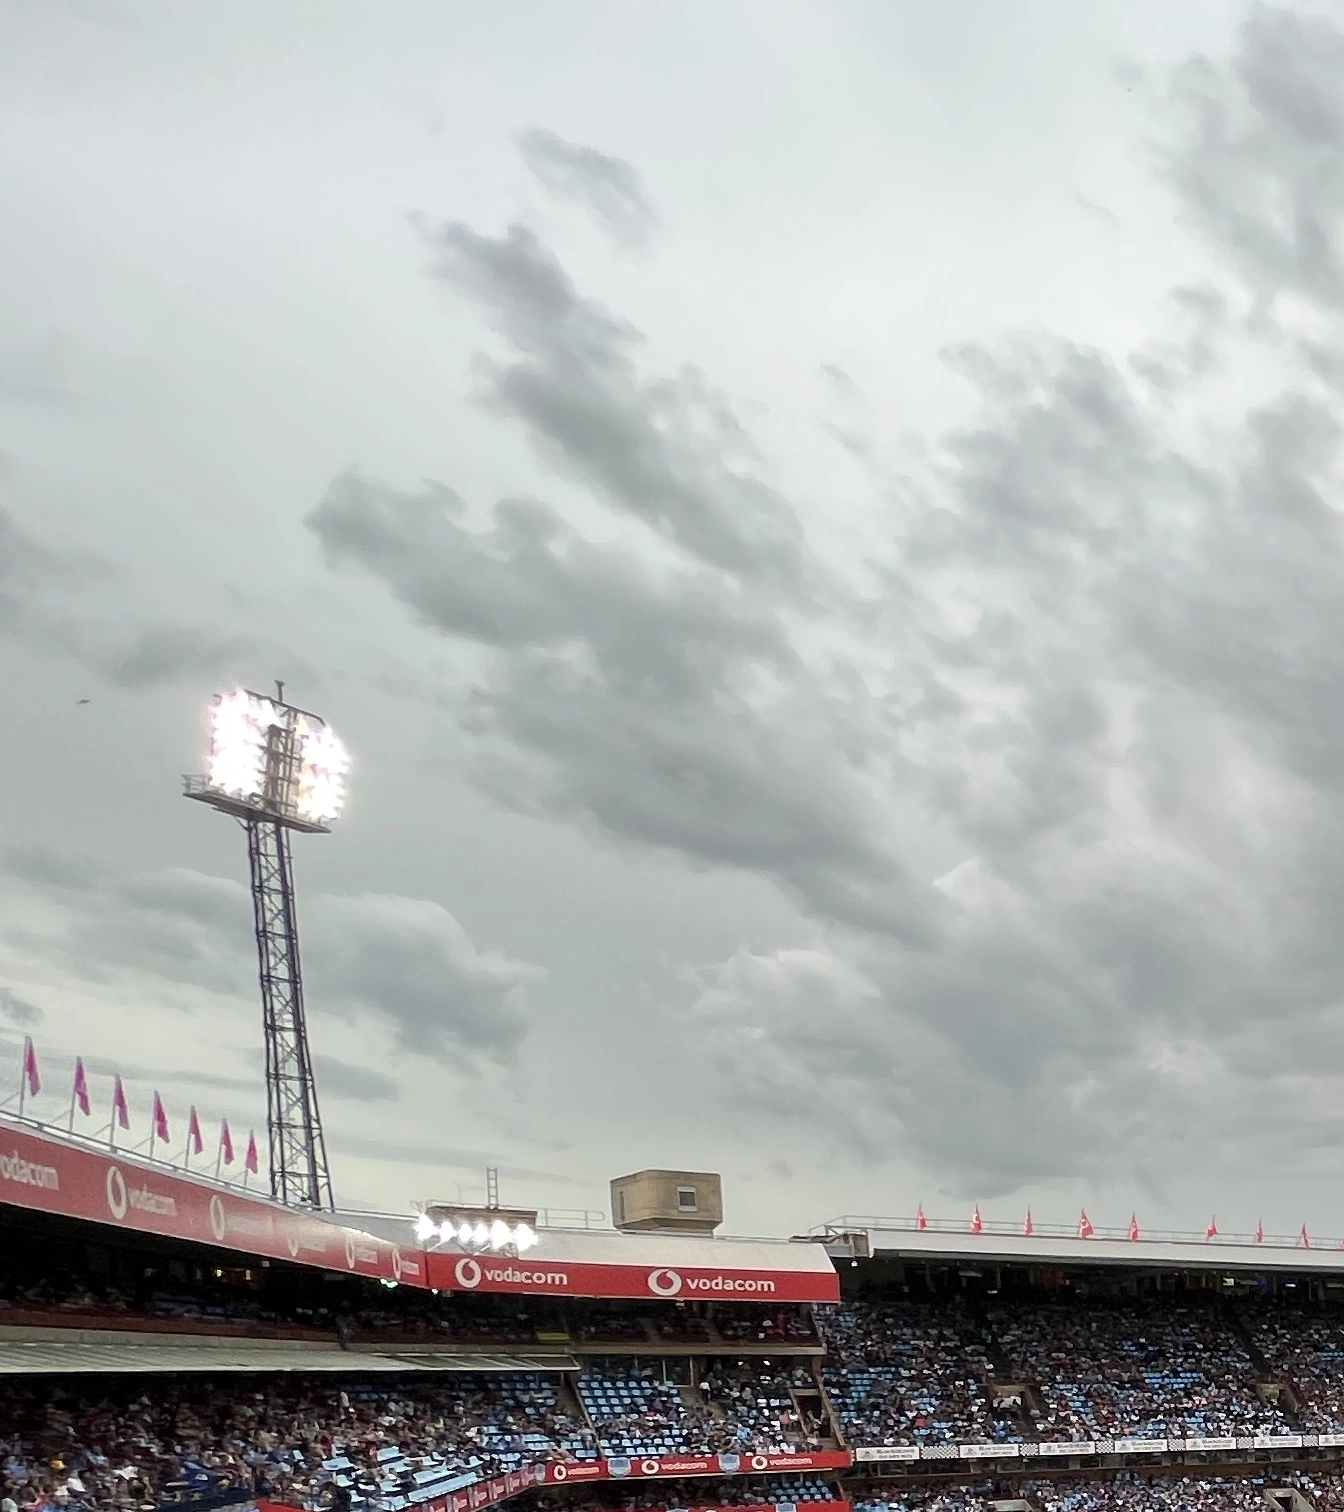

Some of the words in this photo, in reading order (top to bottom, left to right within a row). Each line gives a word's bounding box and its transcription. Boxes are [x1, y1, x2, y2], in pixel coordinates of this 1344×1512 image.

[0, 1149, 59, 1190] odacom
[484, 1266, 568, 1286] vodacom
[686, 1275, 775, 1293] vodacom
